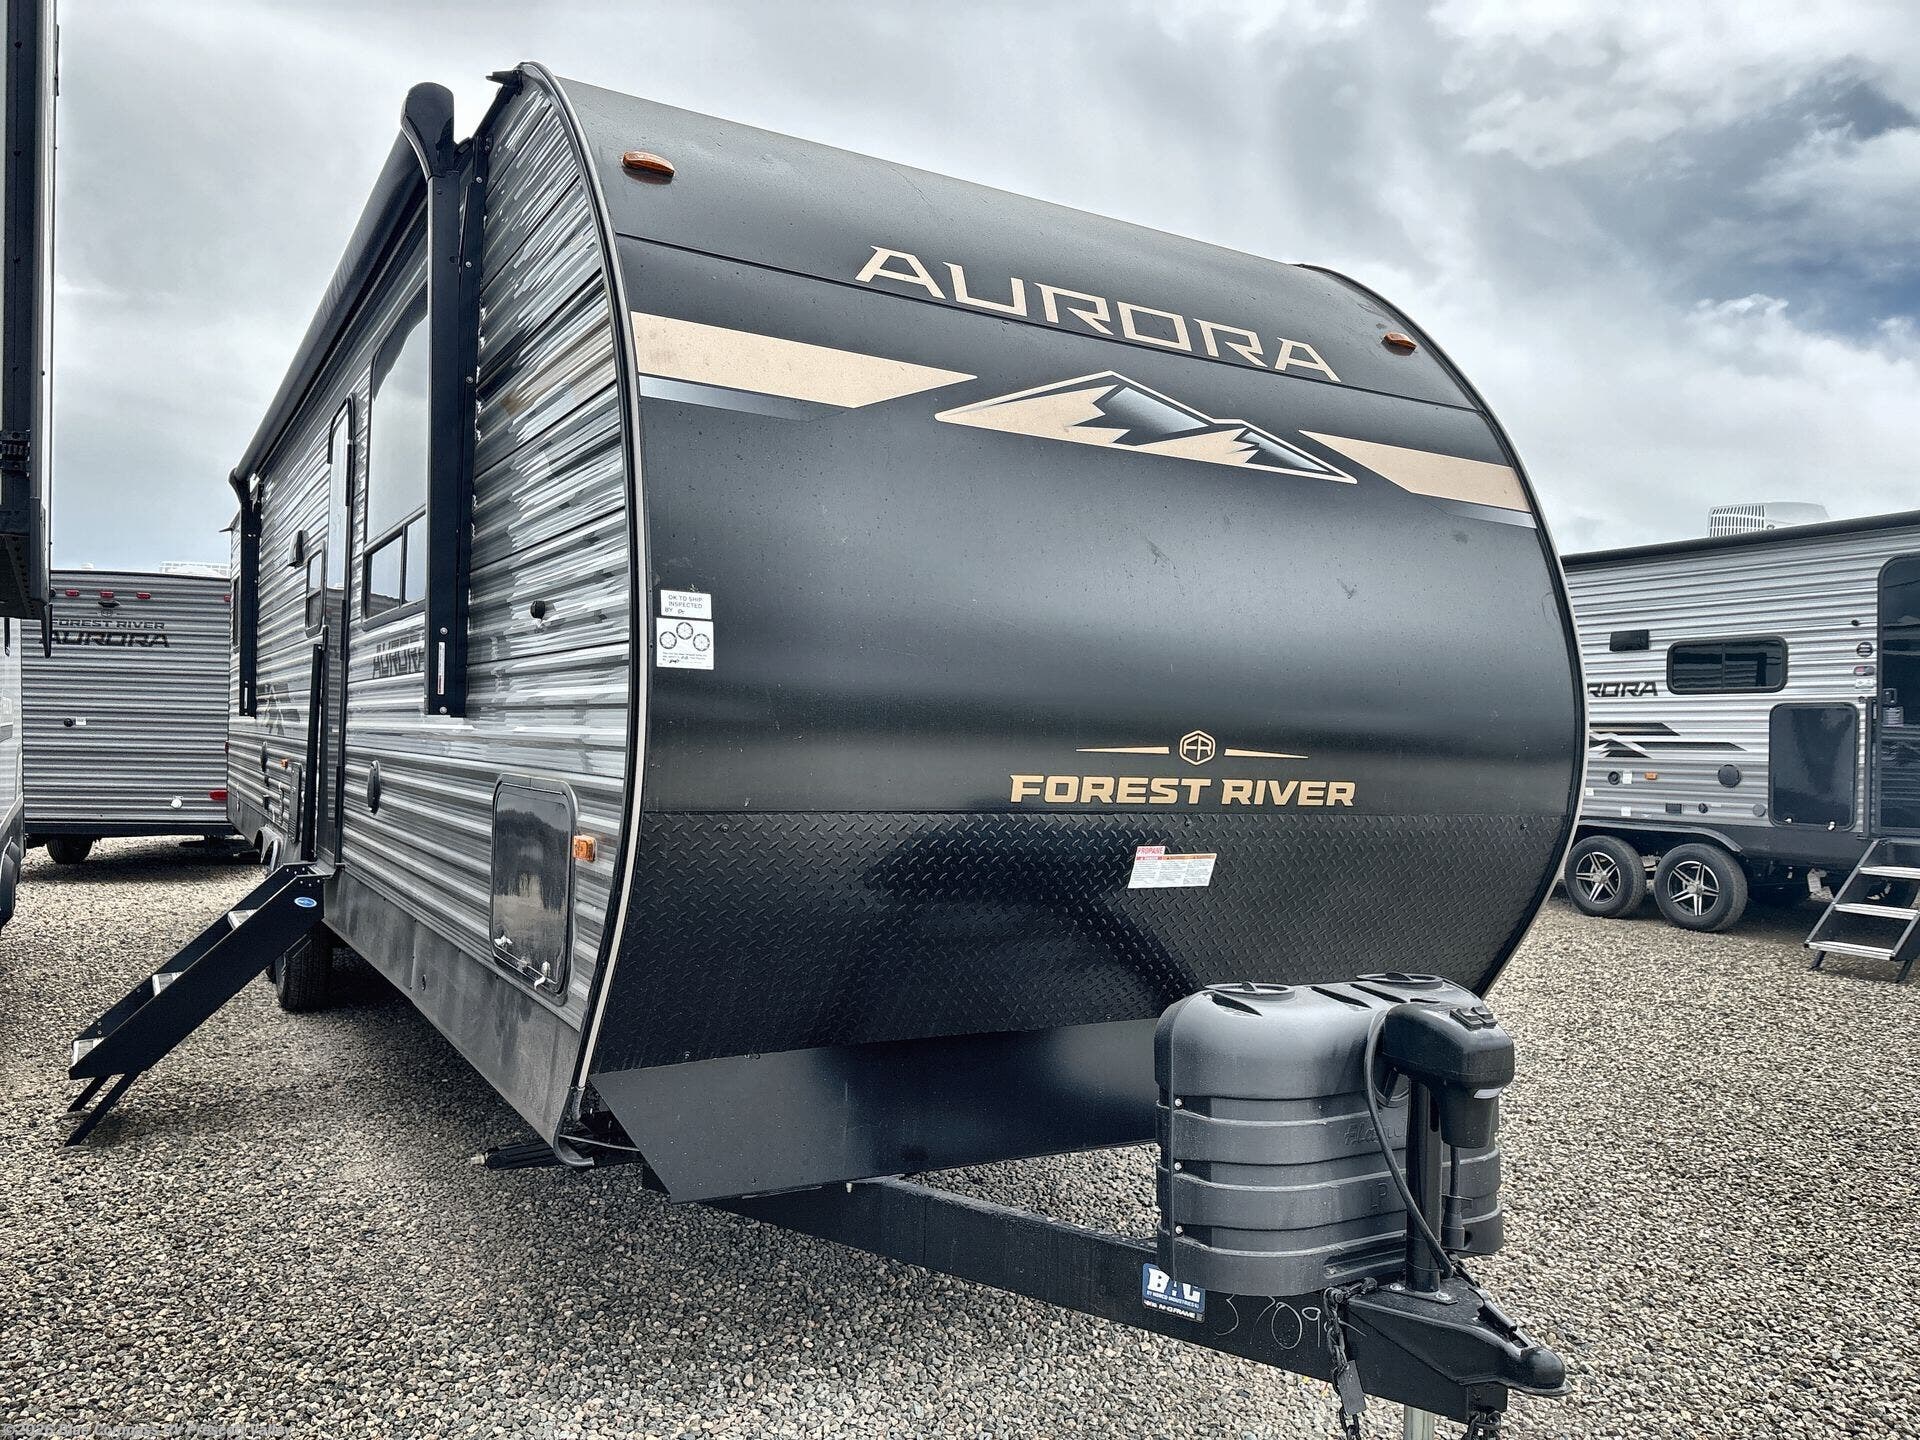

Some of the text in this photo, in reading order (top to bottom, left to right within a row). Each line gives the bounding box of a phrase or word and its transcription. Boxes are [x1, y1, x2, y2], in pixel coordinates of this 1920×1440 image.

[855, 245, 1342, 383] AURORA
[116, 620, 165, 630] RIVER
[1010, 774, 1356, 807] FOREST RIVER
